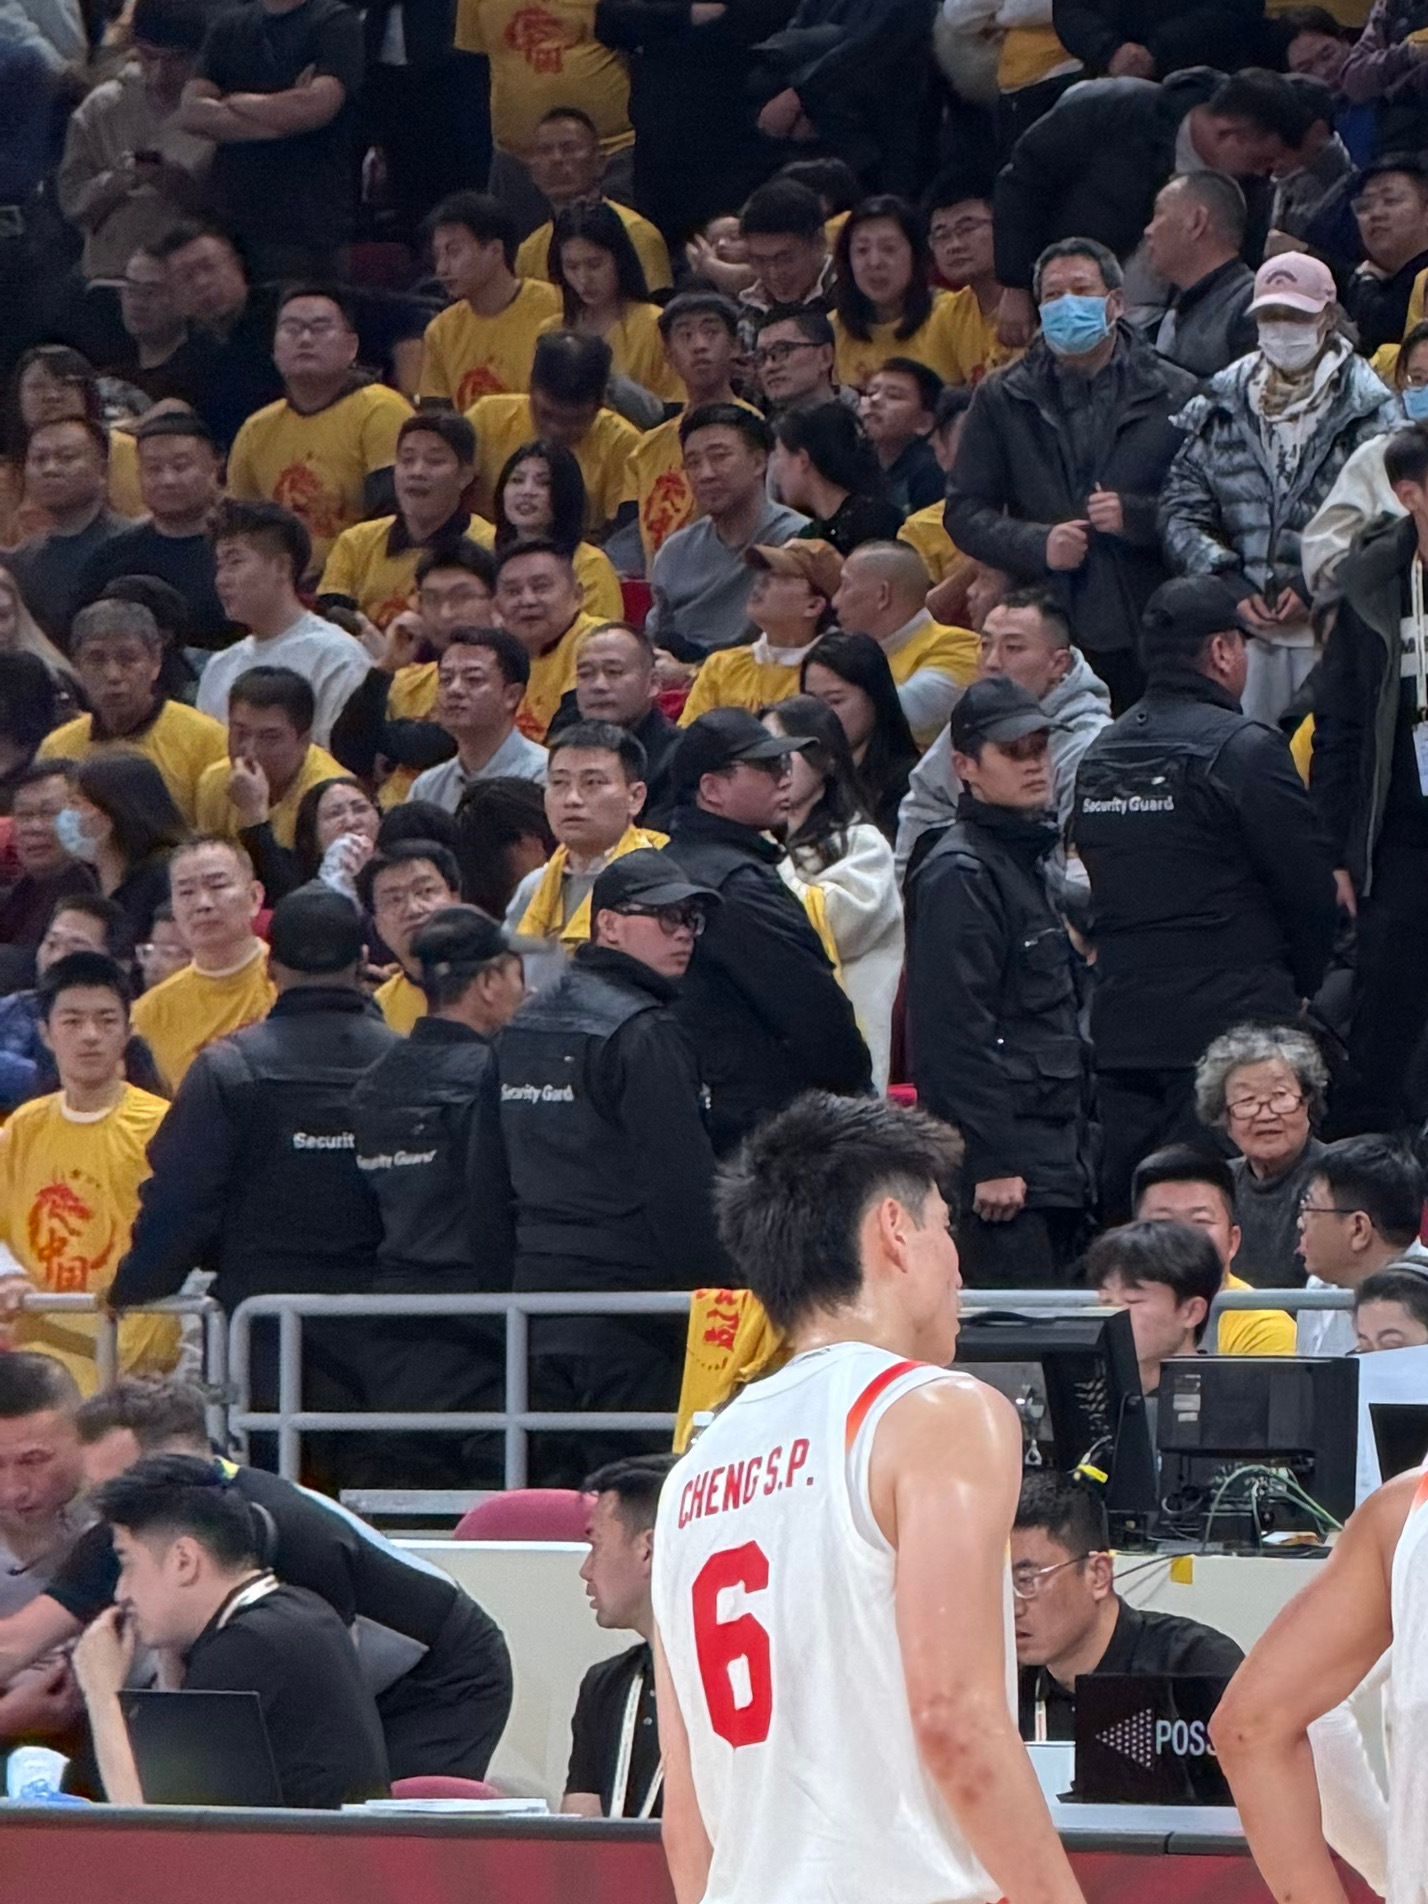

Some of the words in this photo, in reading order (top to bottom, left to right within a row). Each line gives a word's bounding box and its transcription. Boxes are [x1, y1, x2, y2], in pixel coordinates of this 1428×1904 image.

[1082, 796, 1127, 815] Security
[1129, 795, 1174, 812] Guard
[293, 1131, 355, 1149] Securit
[678, 1456, 763, 1530] CHENG
[763, 1438, 814, 1496] S.P.
[691, 1539, 773, 1749] 6
[1155, 1719, 1217, 1756] POS
